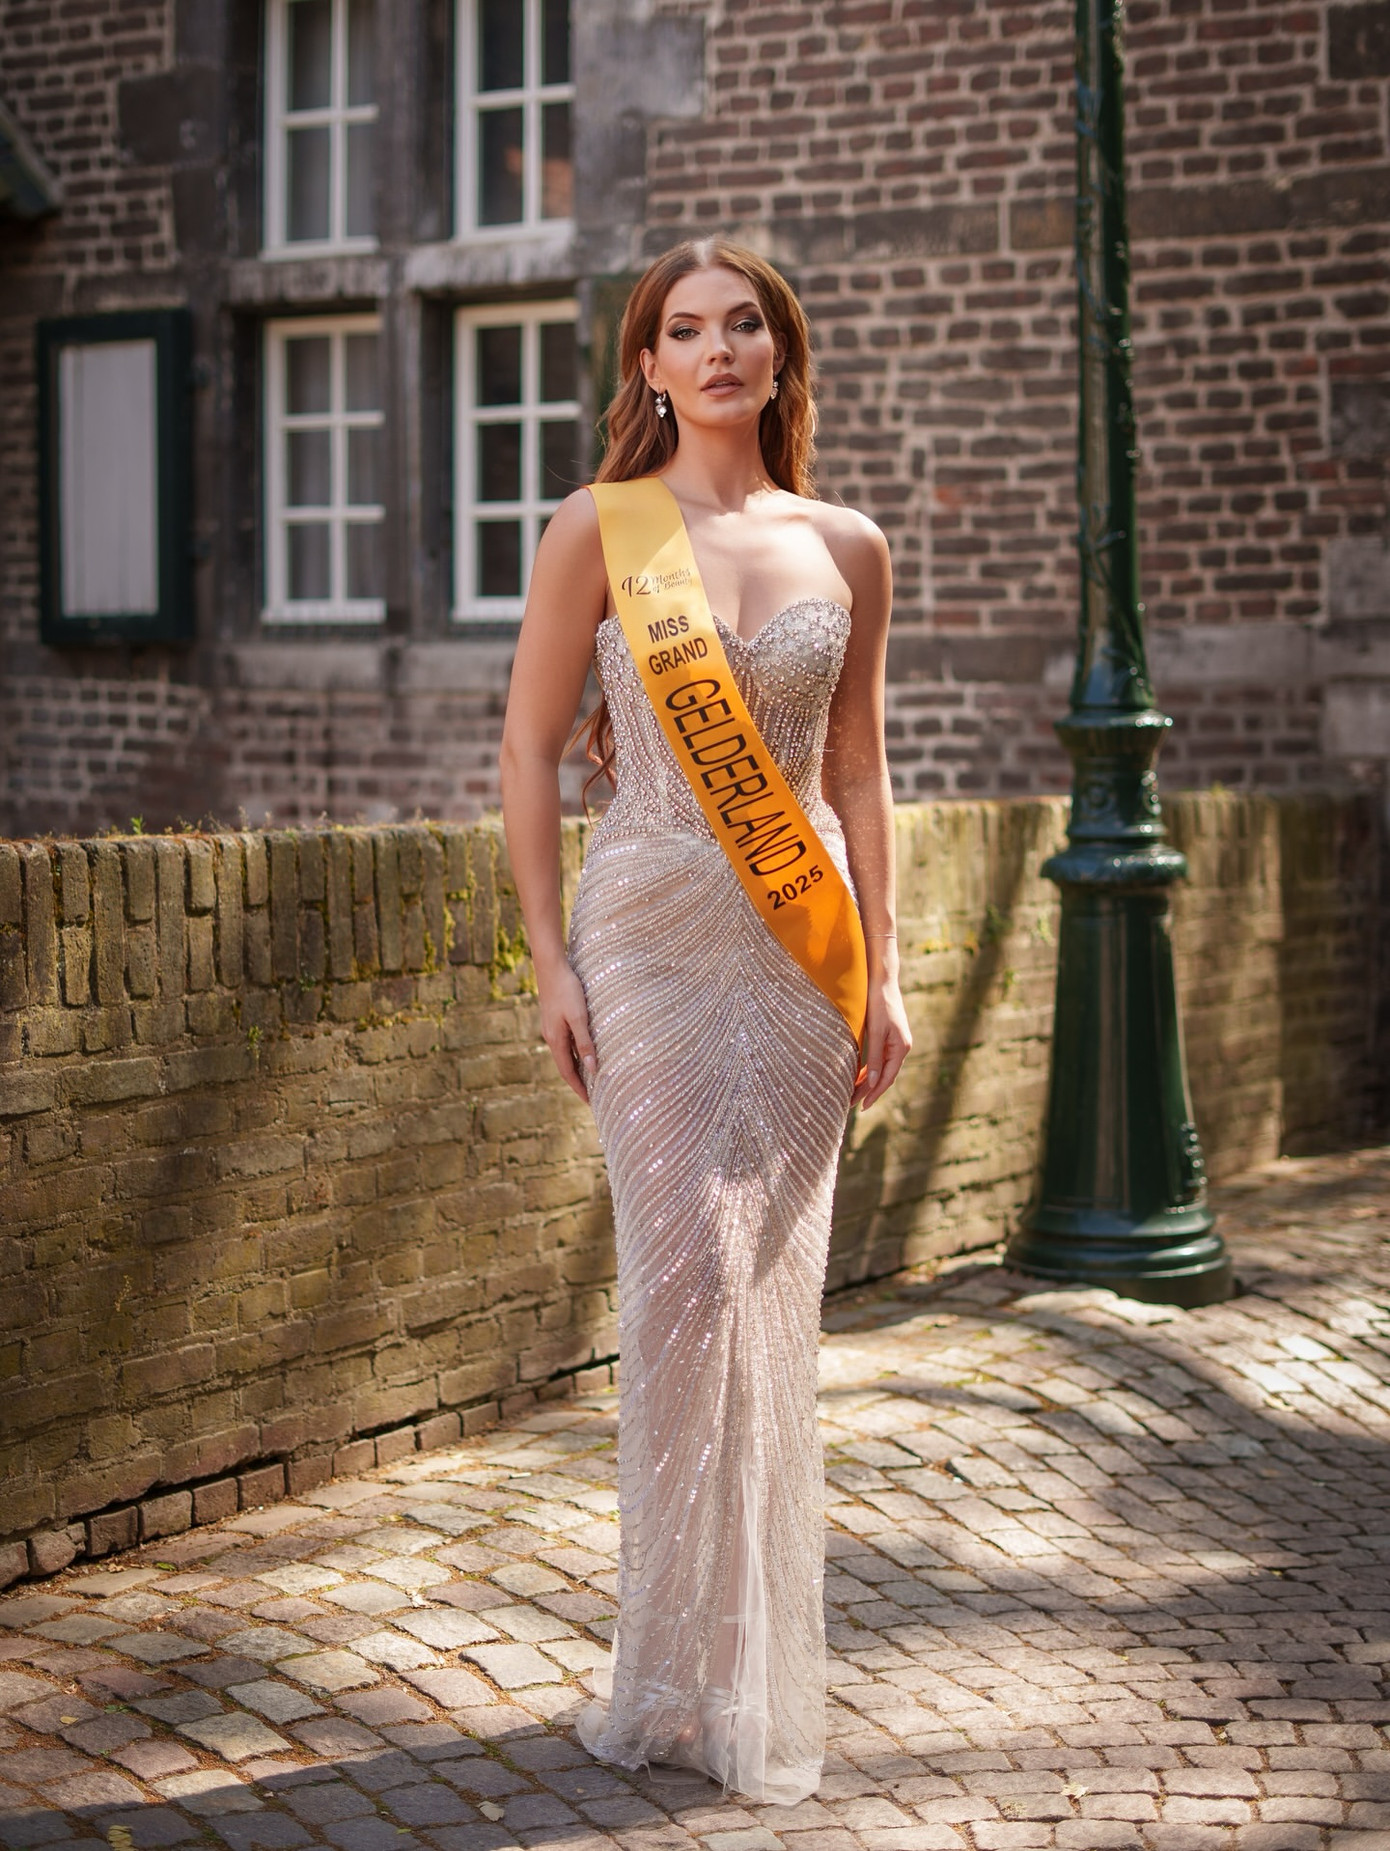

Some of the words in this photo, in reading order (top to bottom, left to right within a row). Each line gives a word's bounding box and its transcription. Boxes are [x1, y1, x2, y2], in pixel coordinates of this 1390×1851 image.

[621, 575, 651, 598] 12
[651, 568, 691, 585] Months
[647, 615, 690, 644] MISS
[648, 637, 708, 676] GRAND
[665, 678, 807, 876] GELDERLAND
[766, 864, 824, 910] 2025
